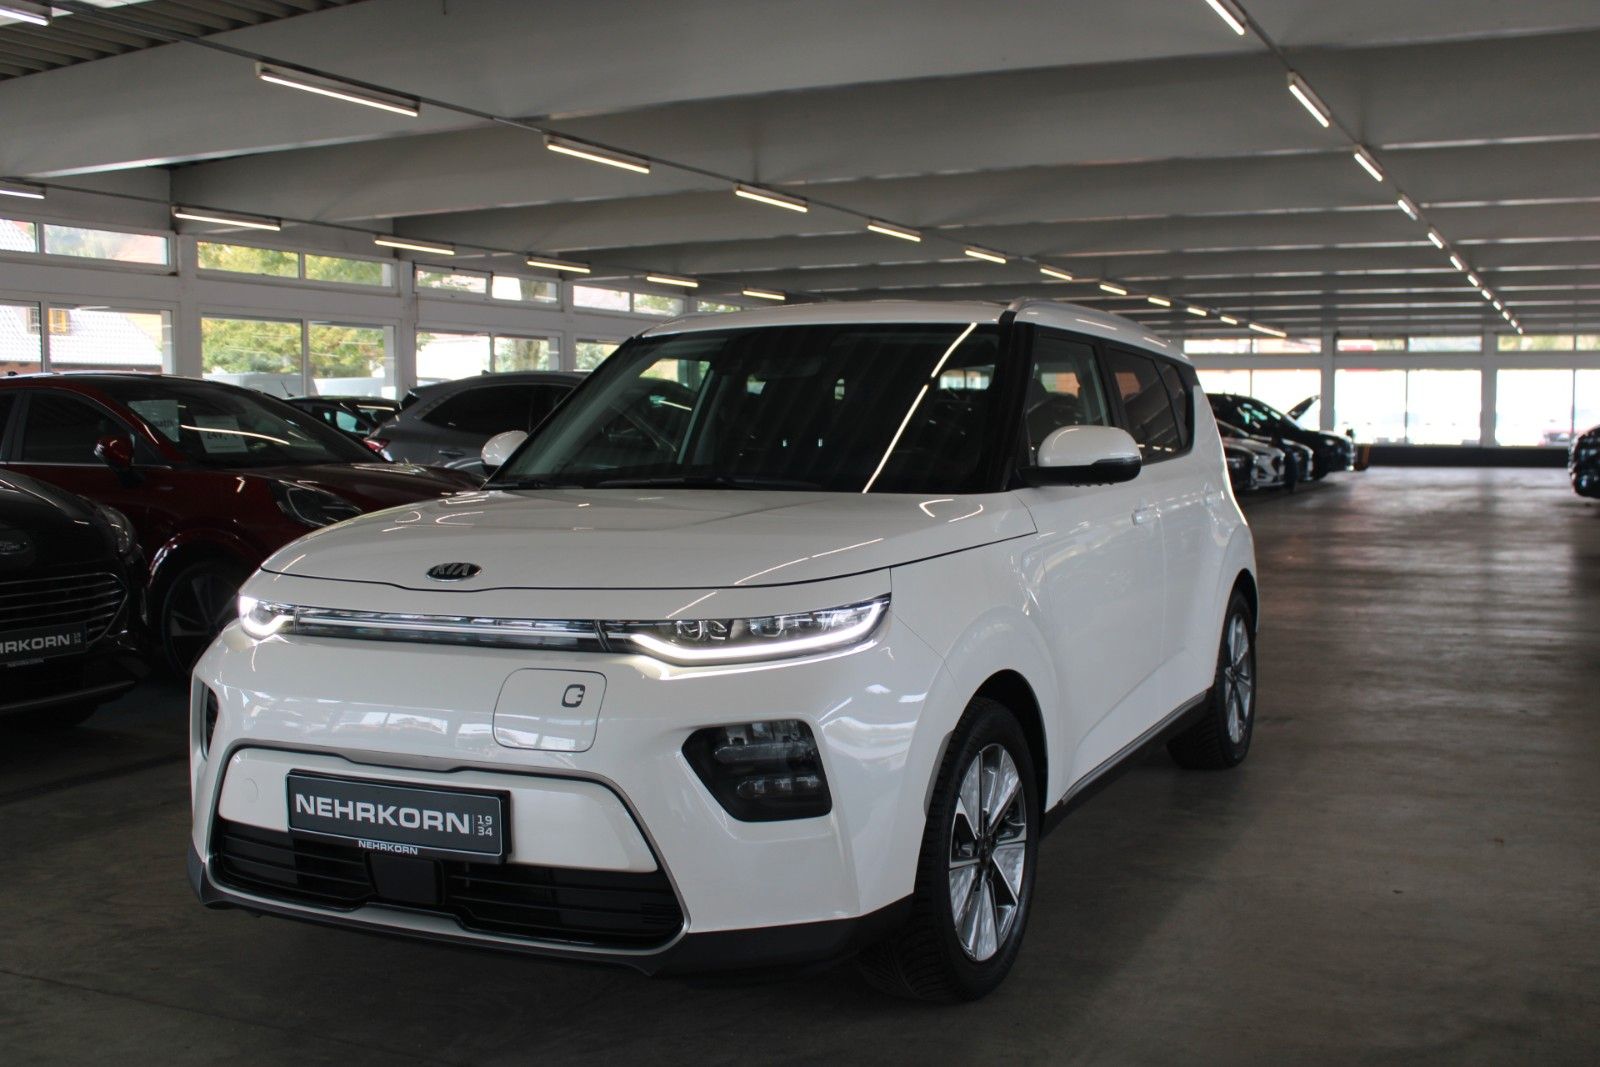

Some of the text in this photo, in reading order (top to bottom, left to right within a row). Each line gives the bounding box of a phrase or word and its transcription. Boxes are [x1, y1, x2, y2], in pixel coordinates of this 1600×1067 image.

[431, 563, 470, 577] KIA
[295, 794, 469, 834] NEHRKORN
[477, 815, 492, 825] 19
[477, 827, 492, 837] 34
[358, 840, 418, 855] NEHRKORN
